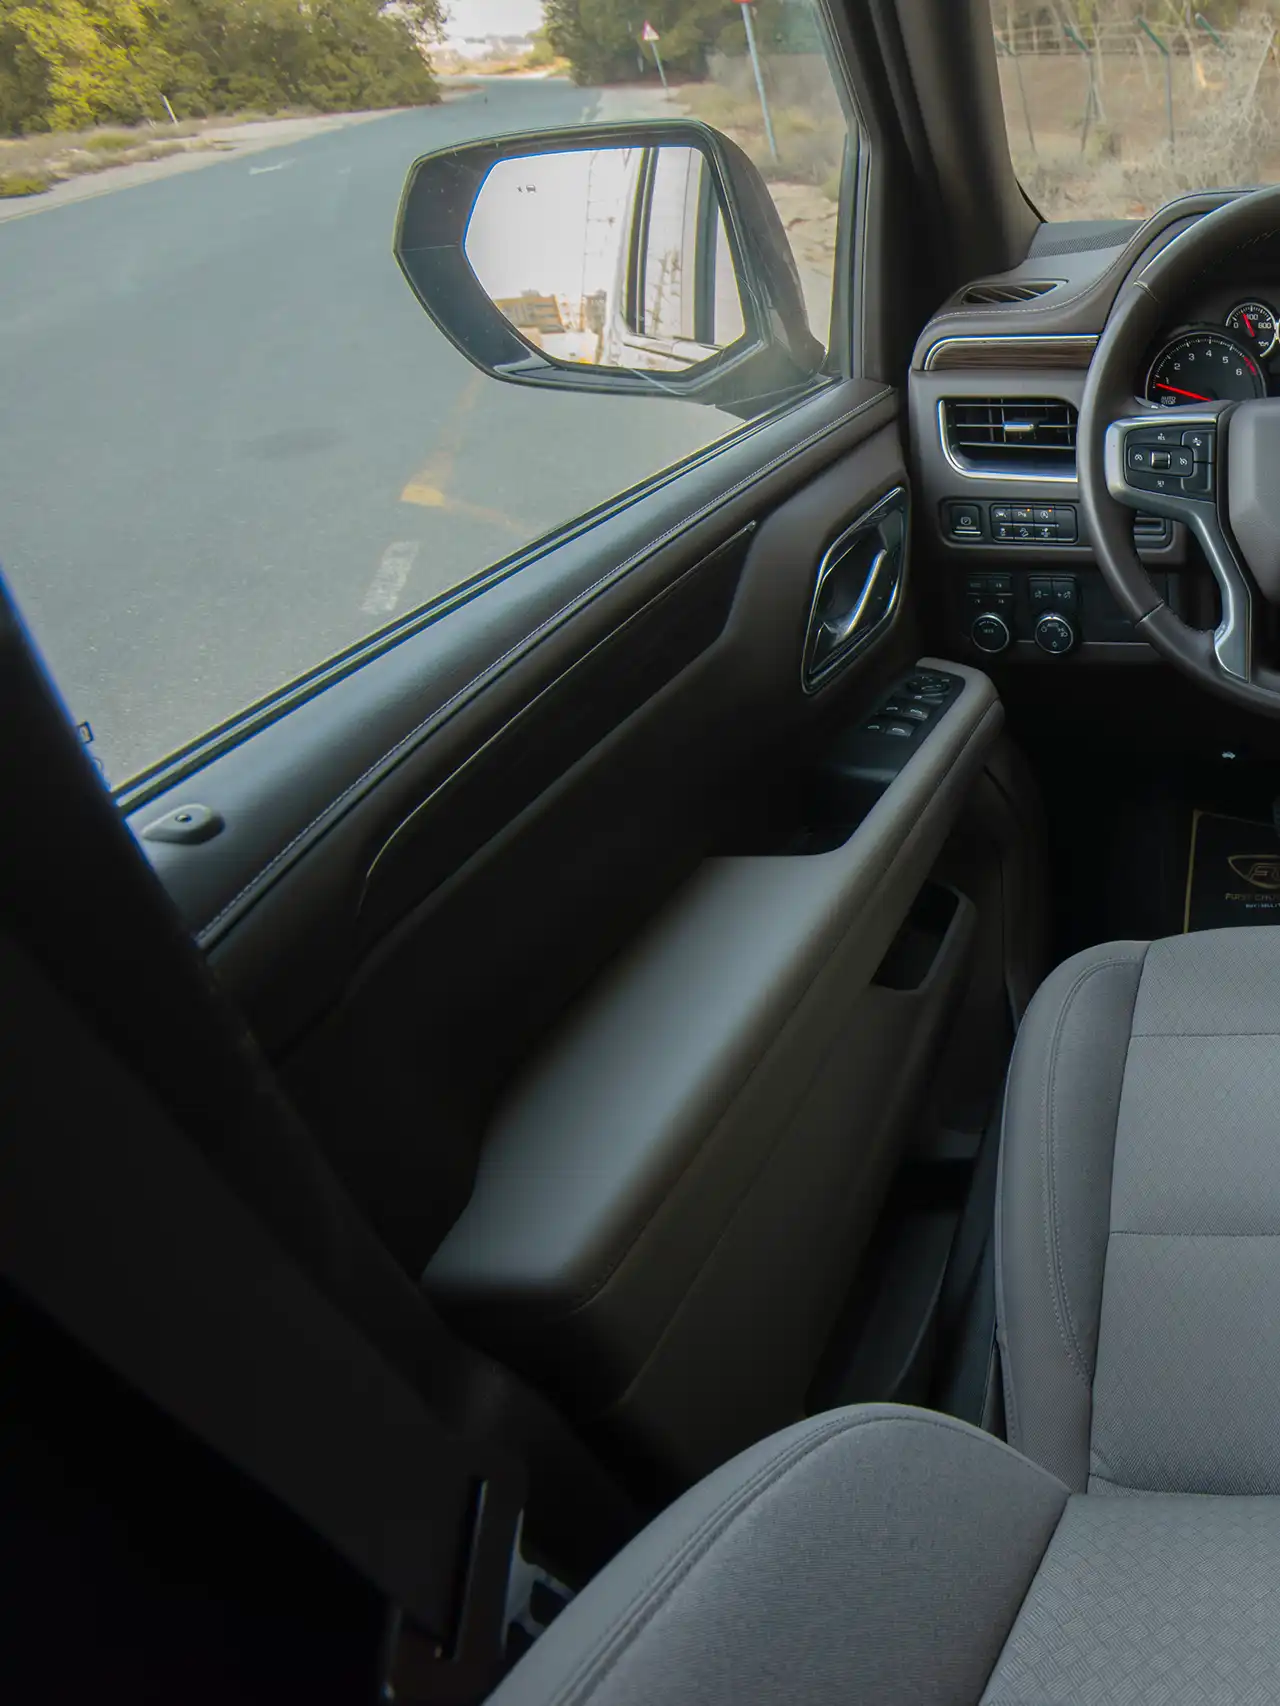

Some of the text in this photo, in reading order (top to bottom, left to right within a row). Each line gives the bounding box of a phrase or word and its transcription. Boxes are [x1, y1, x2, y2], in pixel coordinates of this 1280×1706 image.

[1188, 353, 1195, 361] 3
[1205, 349, 1212, 357] 4
[1222, 356, 1229, 364] 5
[1173, 362, 1181, 371] 2
[1235, 368, 1243, 376] 6
